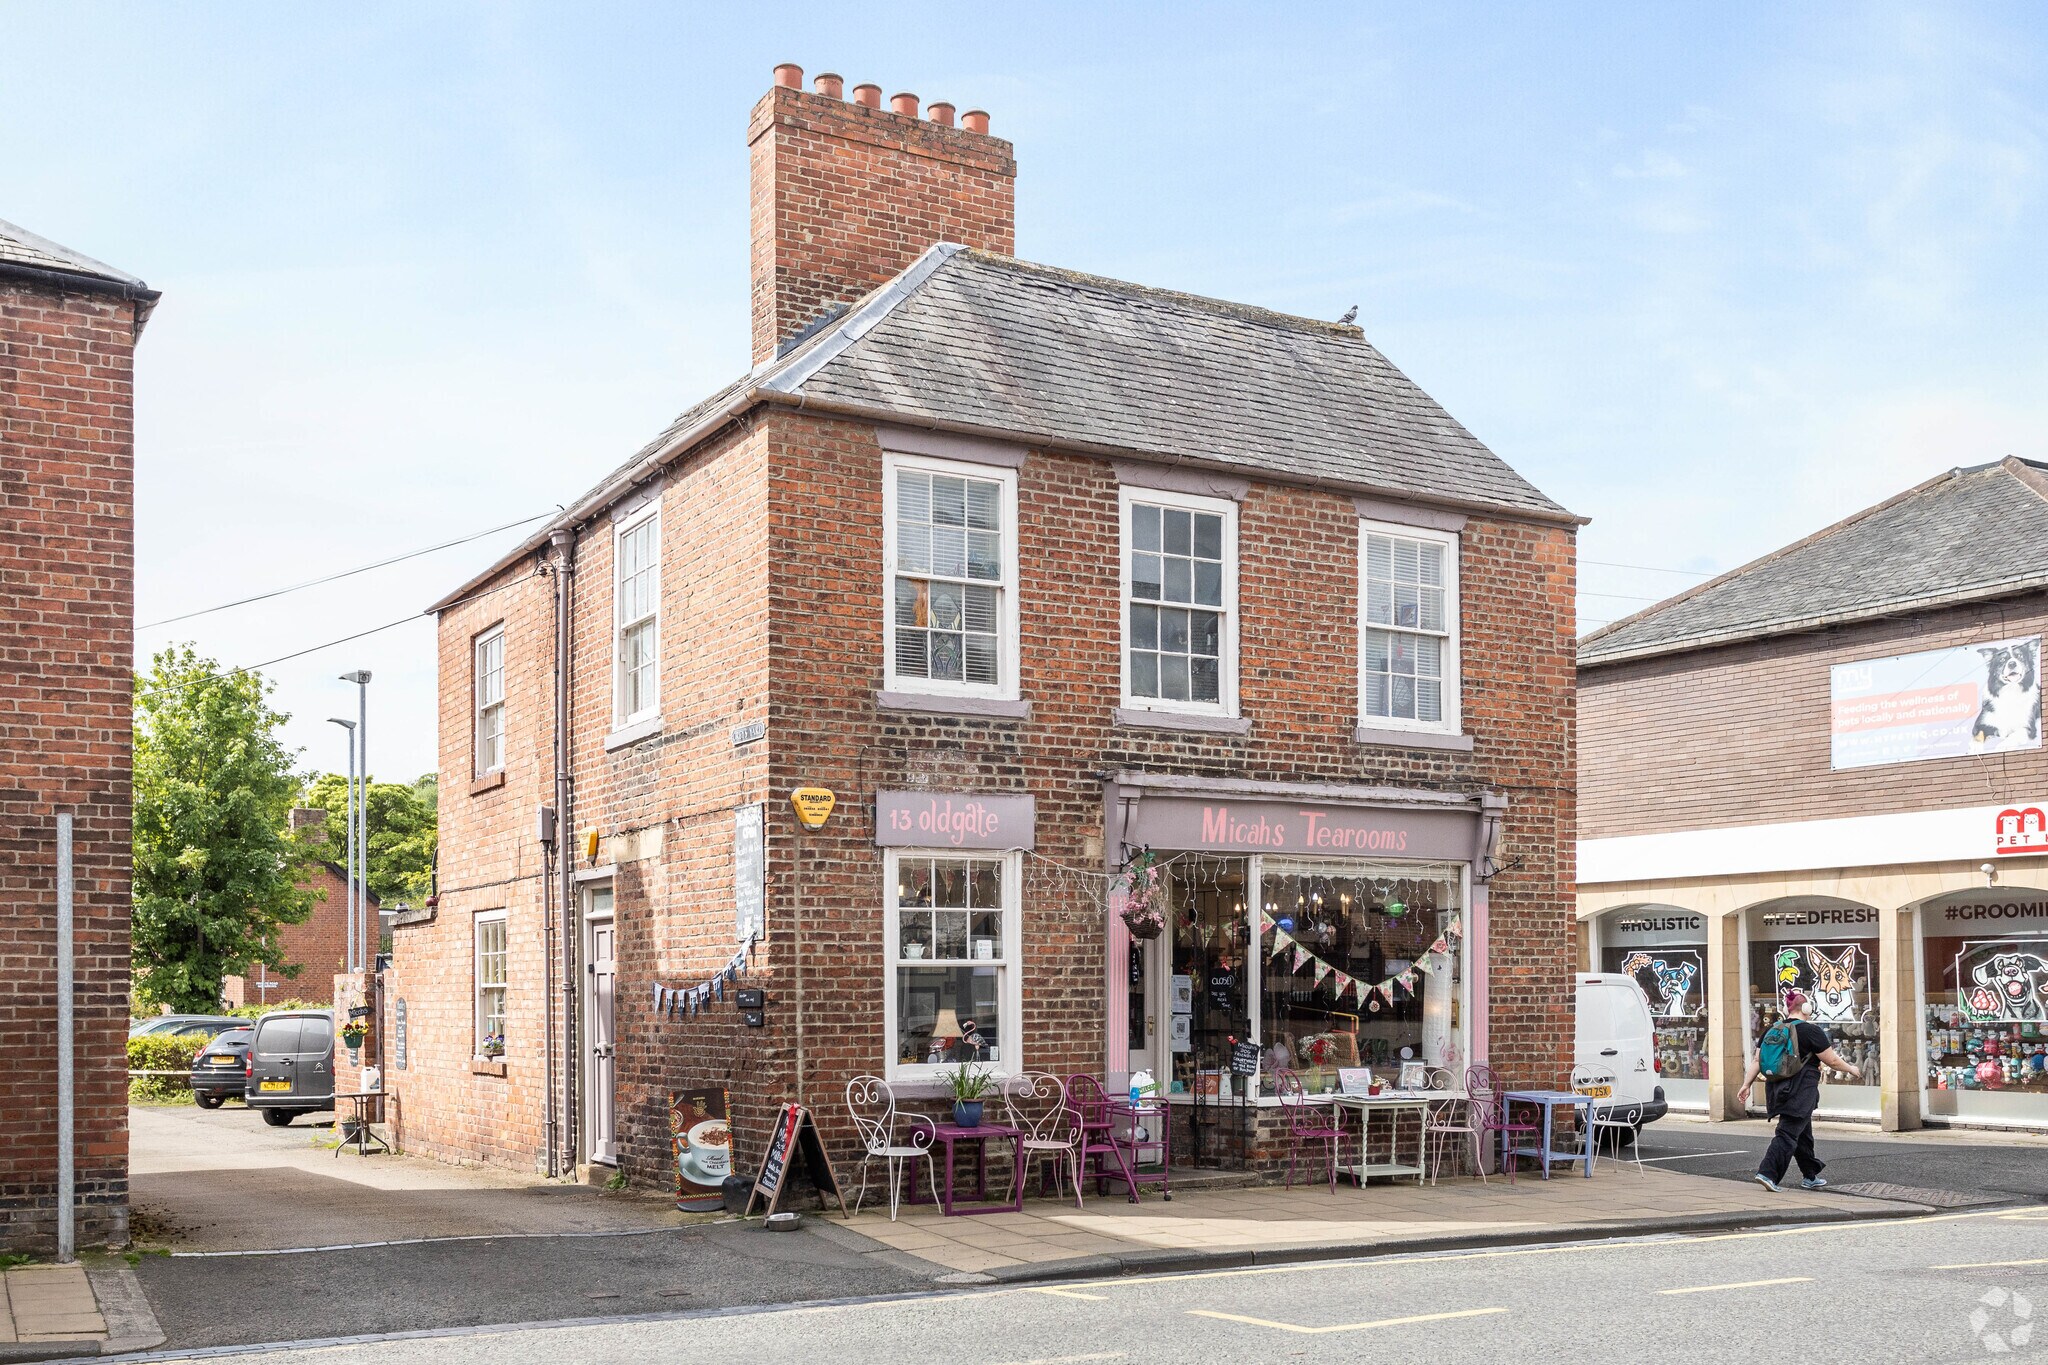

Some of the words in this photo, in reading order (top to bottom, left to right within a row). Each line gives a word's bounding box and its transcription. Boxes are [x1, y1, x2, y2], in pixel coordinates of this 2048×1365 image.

[1838, 702, 1878, 714] Feeding
[1880, 699, 1897, 709] the
[1900, 693, 1944, 706] wellness
[1947, 690, 1959, 700] of
[1838, 717, 1859, 728] pets
[1861, 711, 1894, 723] locally
[1896, 709, 1916, 720] and
[1918, 702, 1971, 717] nationally
[800, 794, 832, 802] STANDARD
[889, 809, 912, 831] 13
[918, 799, 999, 845] oldgate
[1201, 806, 1285, 847] Micahs
[1300, 811, 1408, 851] Tearooms
[1997, 834, 2030, 846] PET
[1620, 916, 1700, 932] #HOLISTIC
[1763, 908, 1880, 927] #FEEDFRESH
[1594, 1085, 1609, 1097] ZSX
